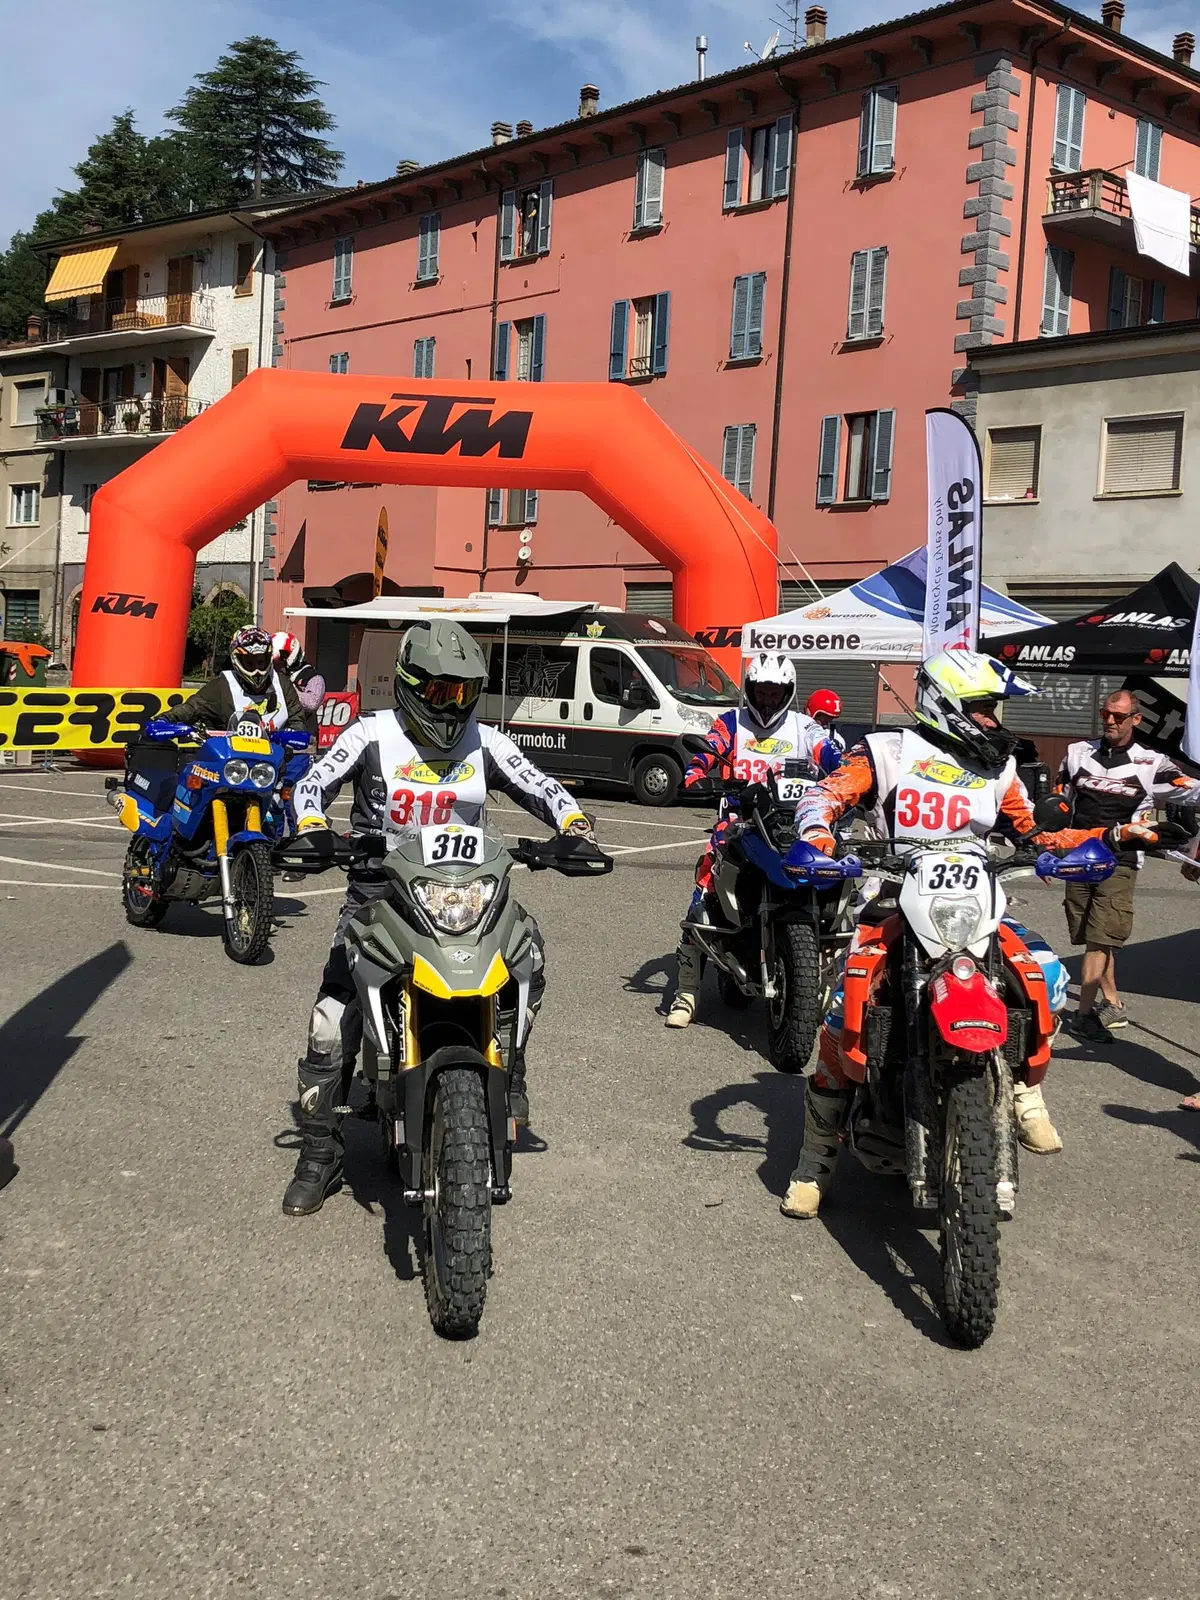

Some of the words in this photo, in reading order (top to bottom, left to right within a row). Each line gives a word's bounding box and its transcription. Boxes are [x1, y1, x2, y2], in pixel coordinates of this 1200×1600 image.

[340, 393, 533, 459] KTM
[90, 592, 158, 619] KTM
[1103, 611, 1191, 628] ANLAS
[749, 629, 861, 650] kerosene
[860, 641, 914, 659] racing
[1017, 645, 1076, 662] ANLAS
[238, 724, 260, 738] 331
[734, 758, 784, 783] 33
[390, 788, 458, 826] 318
[897, 787, 971, 833] 336
[431, 833, 478, 860] 318
[928, 863, 980, 890] 336
